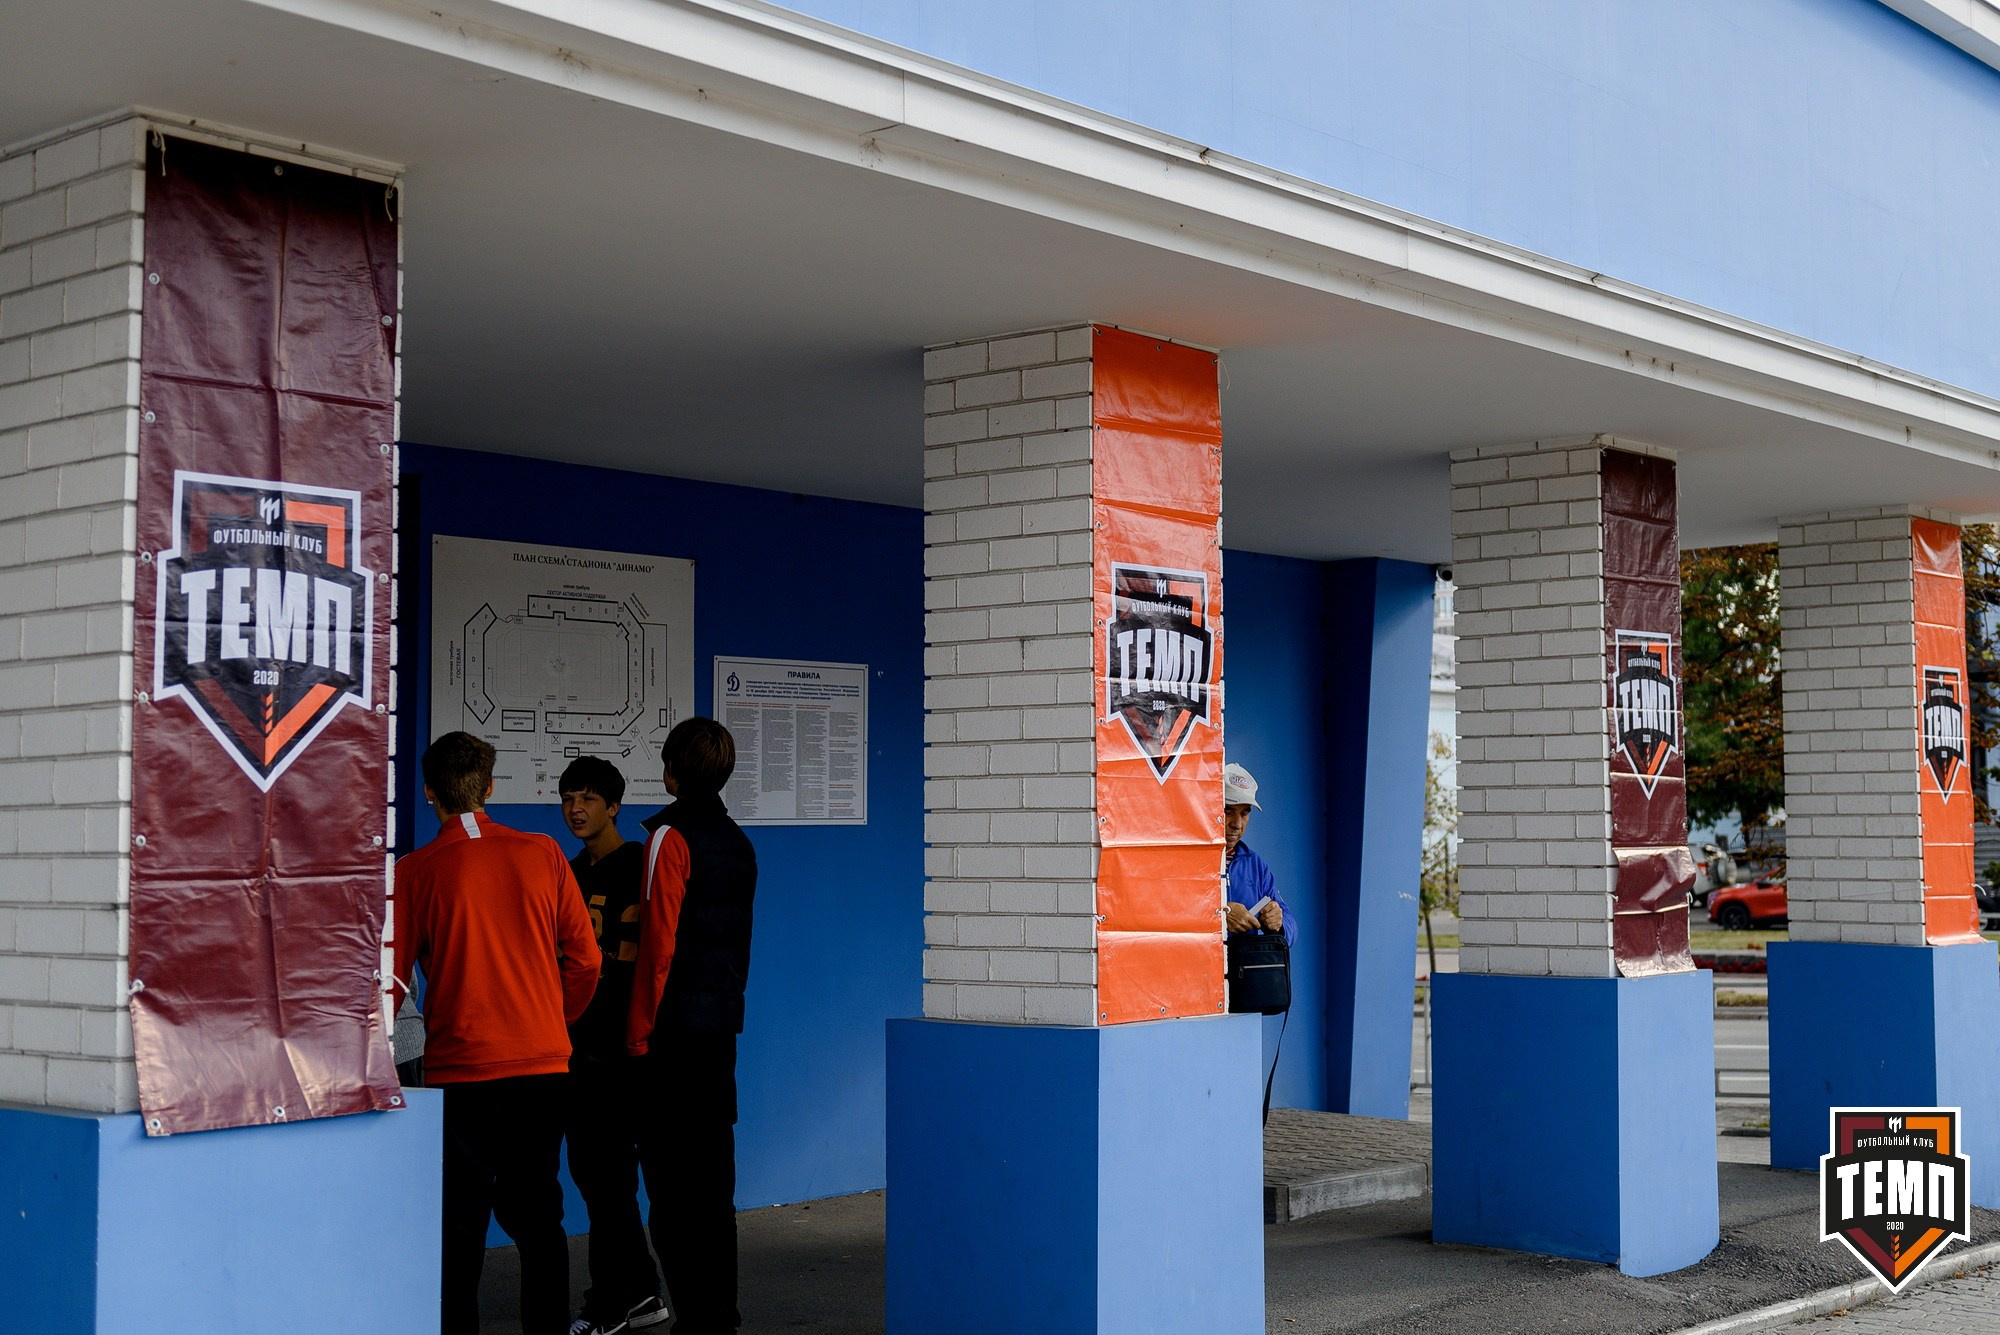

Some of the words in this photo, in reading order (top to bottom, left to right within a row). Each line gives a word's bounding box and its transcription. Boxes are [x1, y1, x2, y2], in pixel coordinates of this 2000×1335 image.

[213, 528, 291, 547] ФУТБОЛЬНЫЙ
[293, 535, 323, 554] КЛУБ
[513, 553, 536, 563] ПЛАН
[537, 555, 565, 566] СХЕМА
[566, 558, 612, 570] СТАДИОНА
[180, 567, 352, 675] ТЕМП
[1131, 600, 1171, 613] ФУТБОЛЬНЫЙ
[1173, 604, 1190, 618] КЛУБ
[253, 670, 279, 685] 2020
[787, 671, 821, 680] ПРАВИЛА
[1116, 628, 1204, 703] ТЕМП
[1619, 678, 1671, 736] ТЕМП
[1925, 705, 1961, 753] ТЕМП
